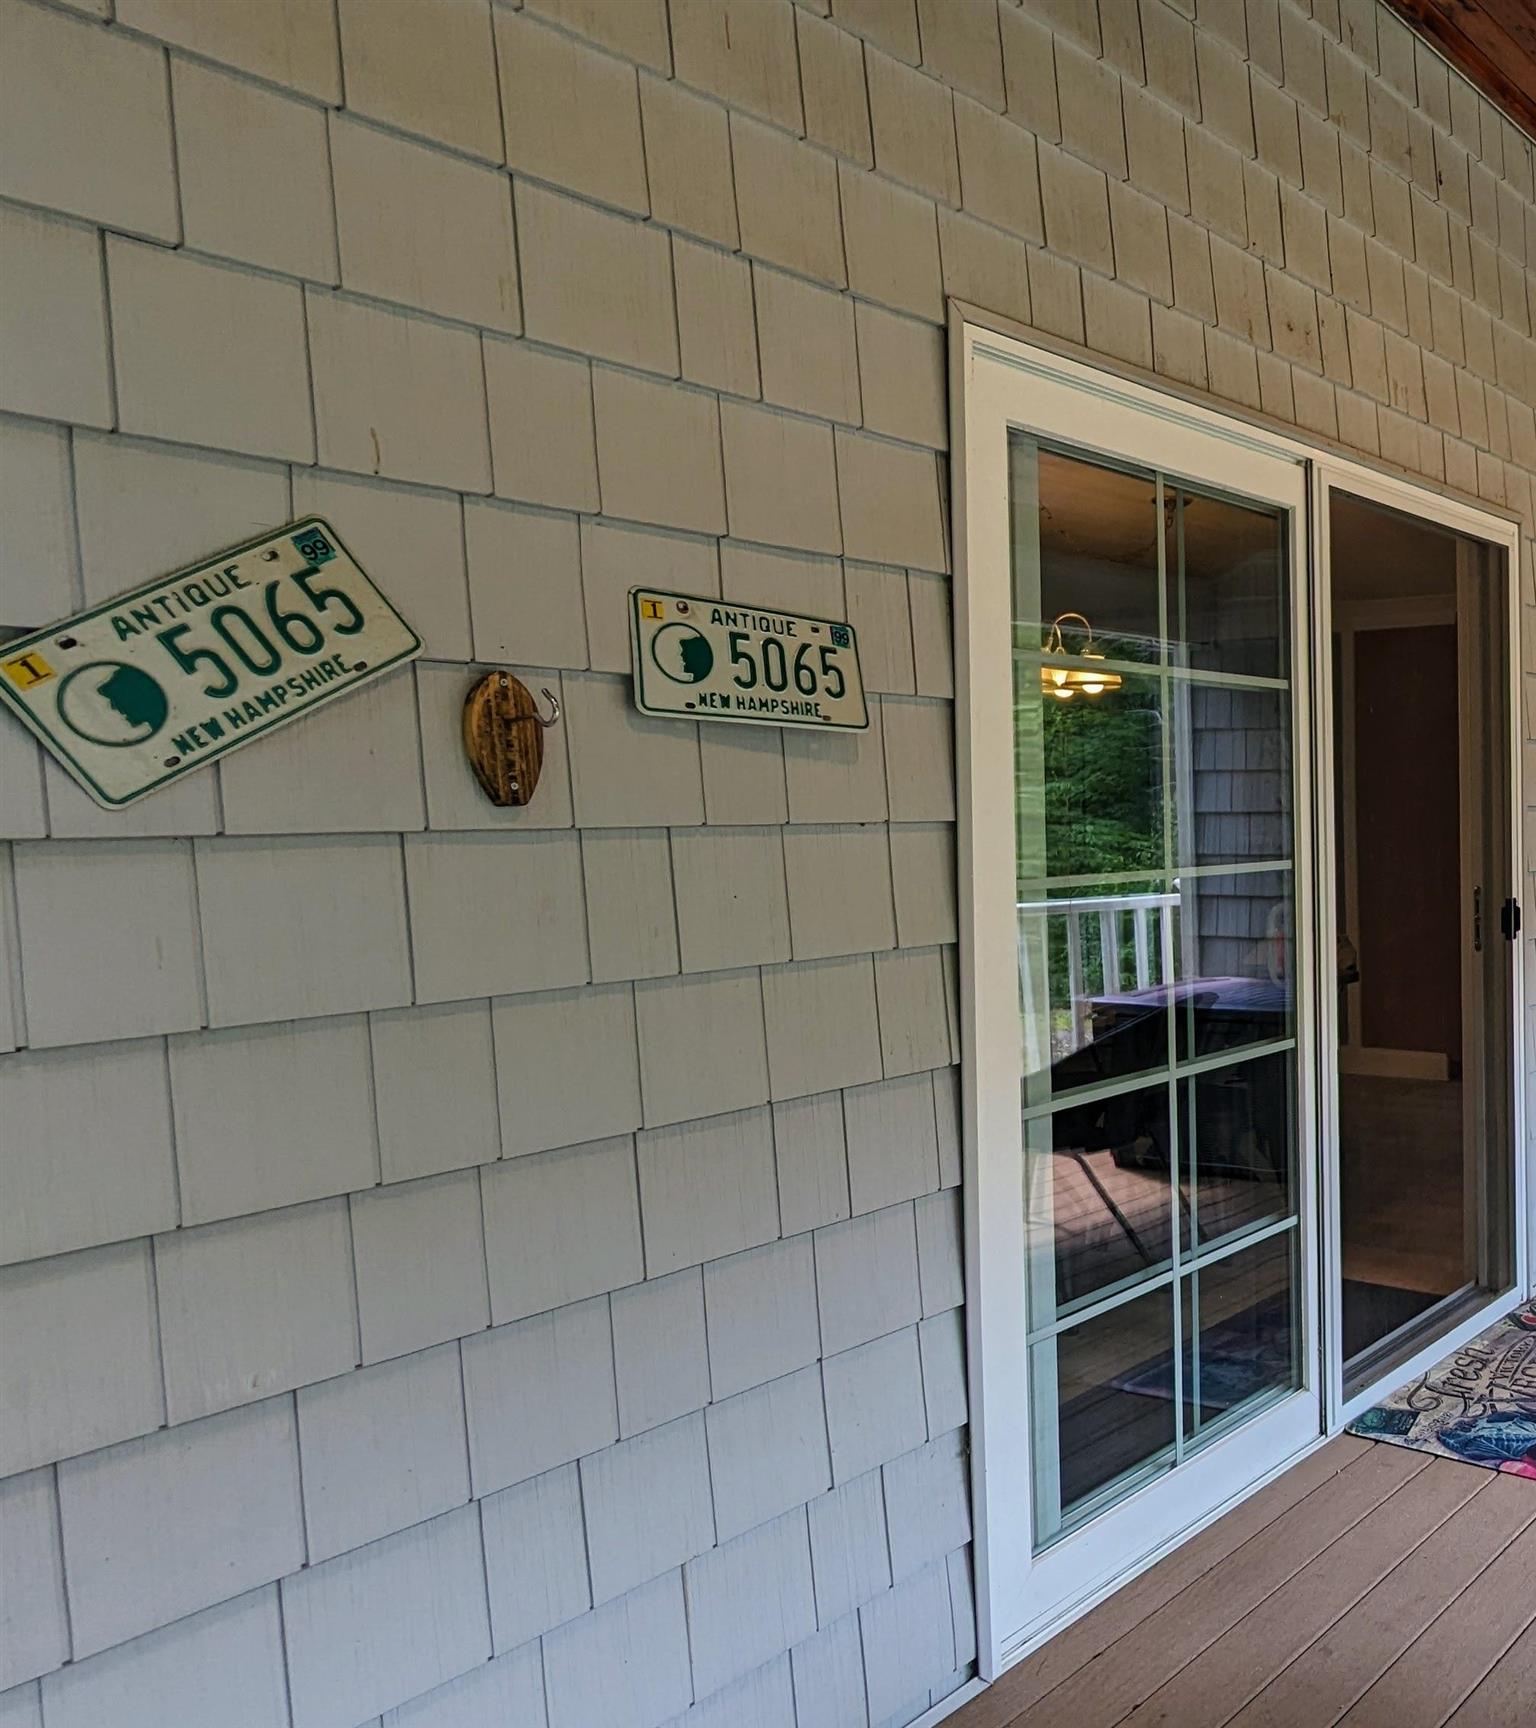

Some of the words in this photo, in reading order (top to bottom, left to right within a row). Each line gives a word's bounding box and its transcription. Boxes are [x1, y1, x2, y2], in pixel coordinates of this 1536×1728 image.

[300, 538, 332, 561] 99
[110, 564, 253, 641] ANTIQUE
[711, 608, 798, 638] ANTIQUE
[155, 566, 365, 699] 5065
[833, 629, 850, 646] 99
[729, 631, 845, 699] 5065
[172, 717, 226, 755] NEW
[221, 652, 353, 731] HAMPSHIRE
[698, 692, 731, 709] NEW
[736, 695, 823, 719] HAMPSHIRE
[1406, 1347, 1496, 1417] Fresh
[1489, 1341, 1531, 1380] VICTORY
